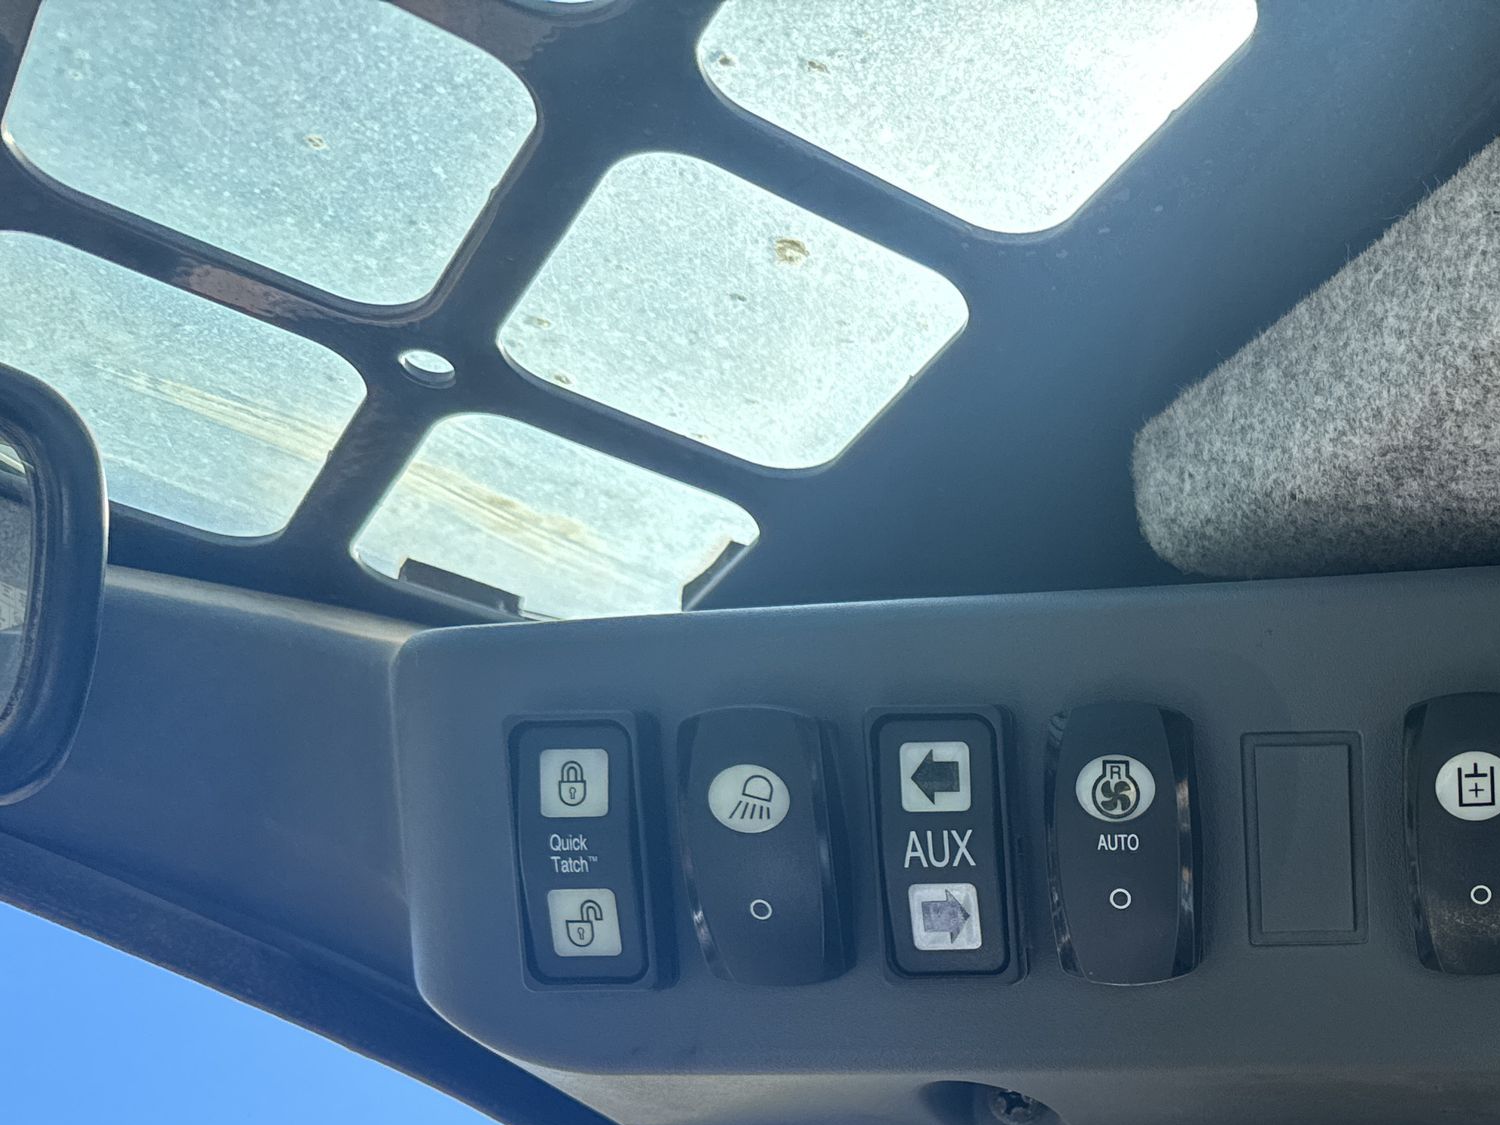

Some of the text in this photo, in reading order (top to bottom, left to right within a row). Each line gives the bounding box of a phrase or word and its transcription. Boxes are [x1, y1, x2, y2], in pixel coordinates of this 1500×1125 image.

[550, 833, 589, 852] Quick
[904, 830, 977, 869] AUX
[1097, 834, 1140, 851] AUTO
